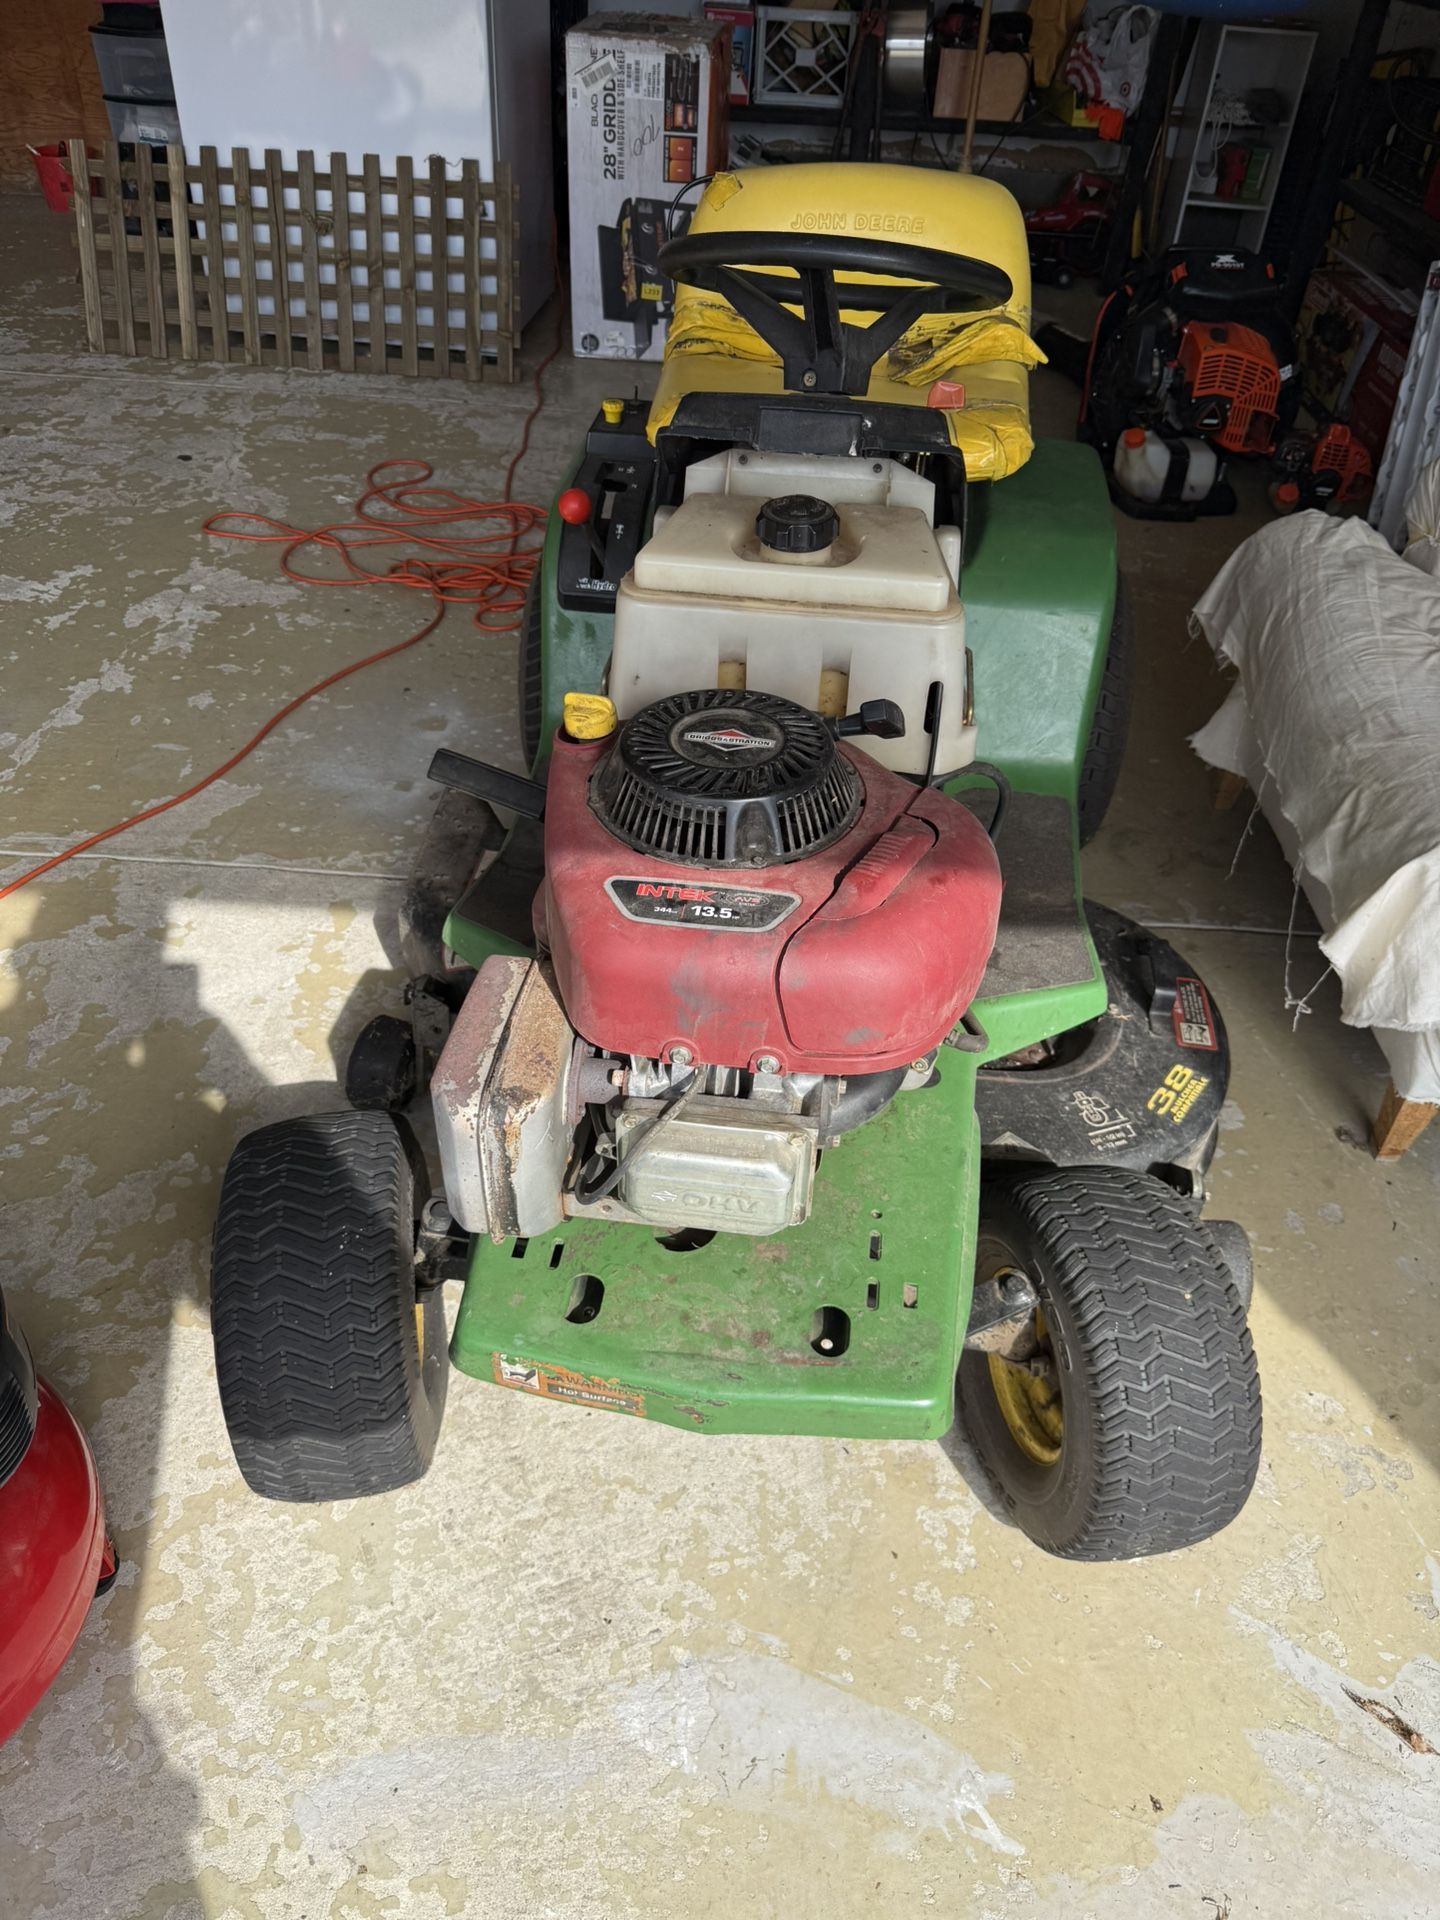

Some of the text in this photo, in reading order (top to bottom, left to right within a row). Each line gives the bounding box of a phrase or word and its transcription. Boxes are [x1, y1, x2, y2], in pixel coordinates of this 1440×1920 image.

[617, 49, 625, 75] SHELF
[590, 47, 599, 127] BLACNE
[617, 79, 625, 97] SIDE
[603, 48, 617, 180] 28" GRIDD
[617, 109, 625, 157] HARDCOVER
[617, 159, 625, 180] WITH
[790, 213, 926, 235] JOHN DEERE
[636, 883, 718, 904] INTEK
[690, 905, 733, 919] 13.5
[1147, 1063, 1194, 1115] 38
[1170, 1079, 1199, 1114] MULCHER
[1173, 1076, 1211, 1123] COMPATIBLE
[681, 1192, 762, 1215] OHV
